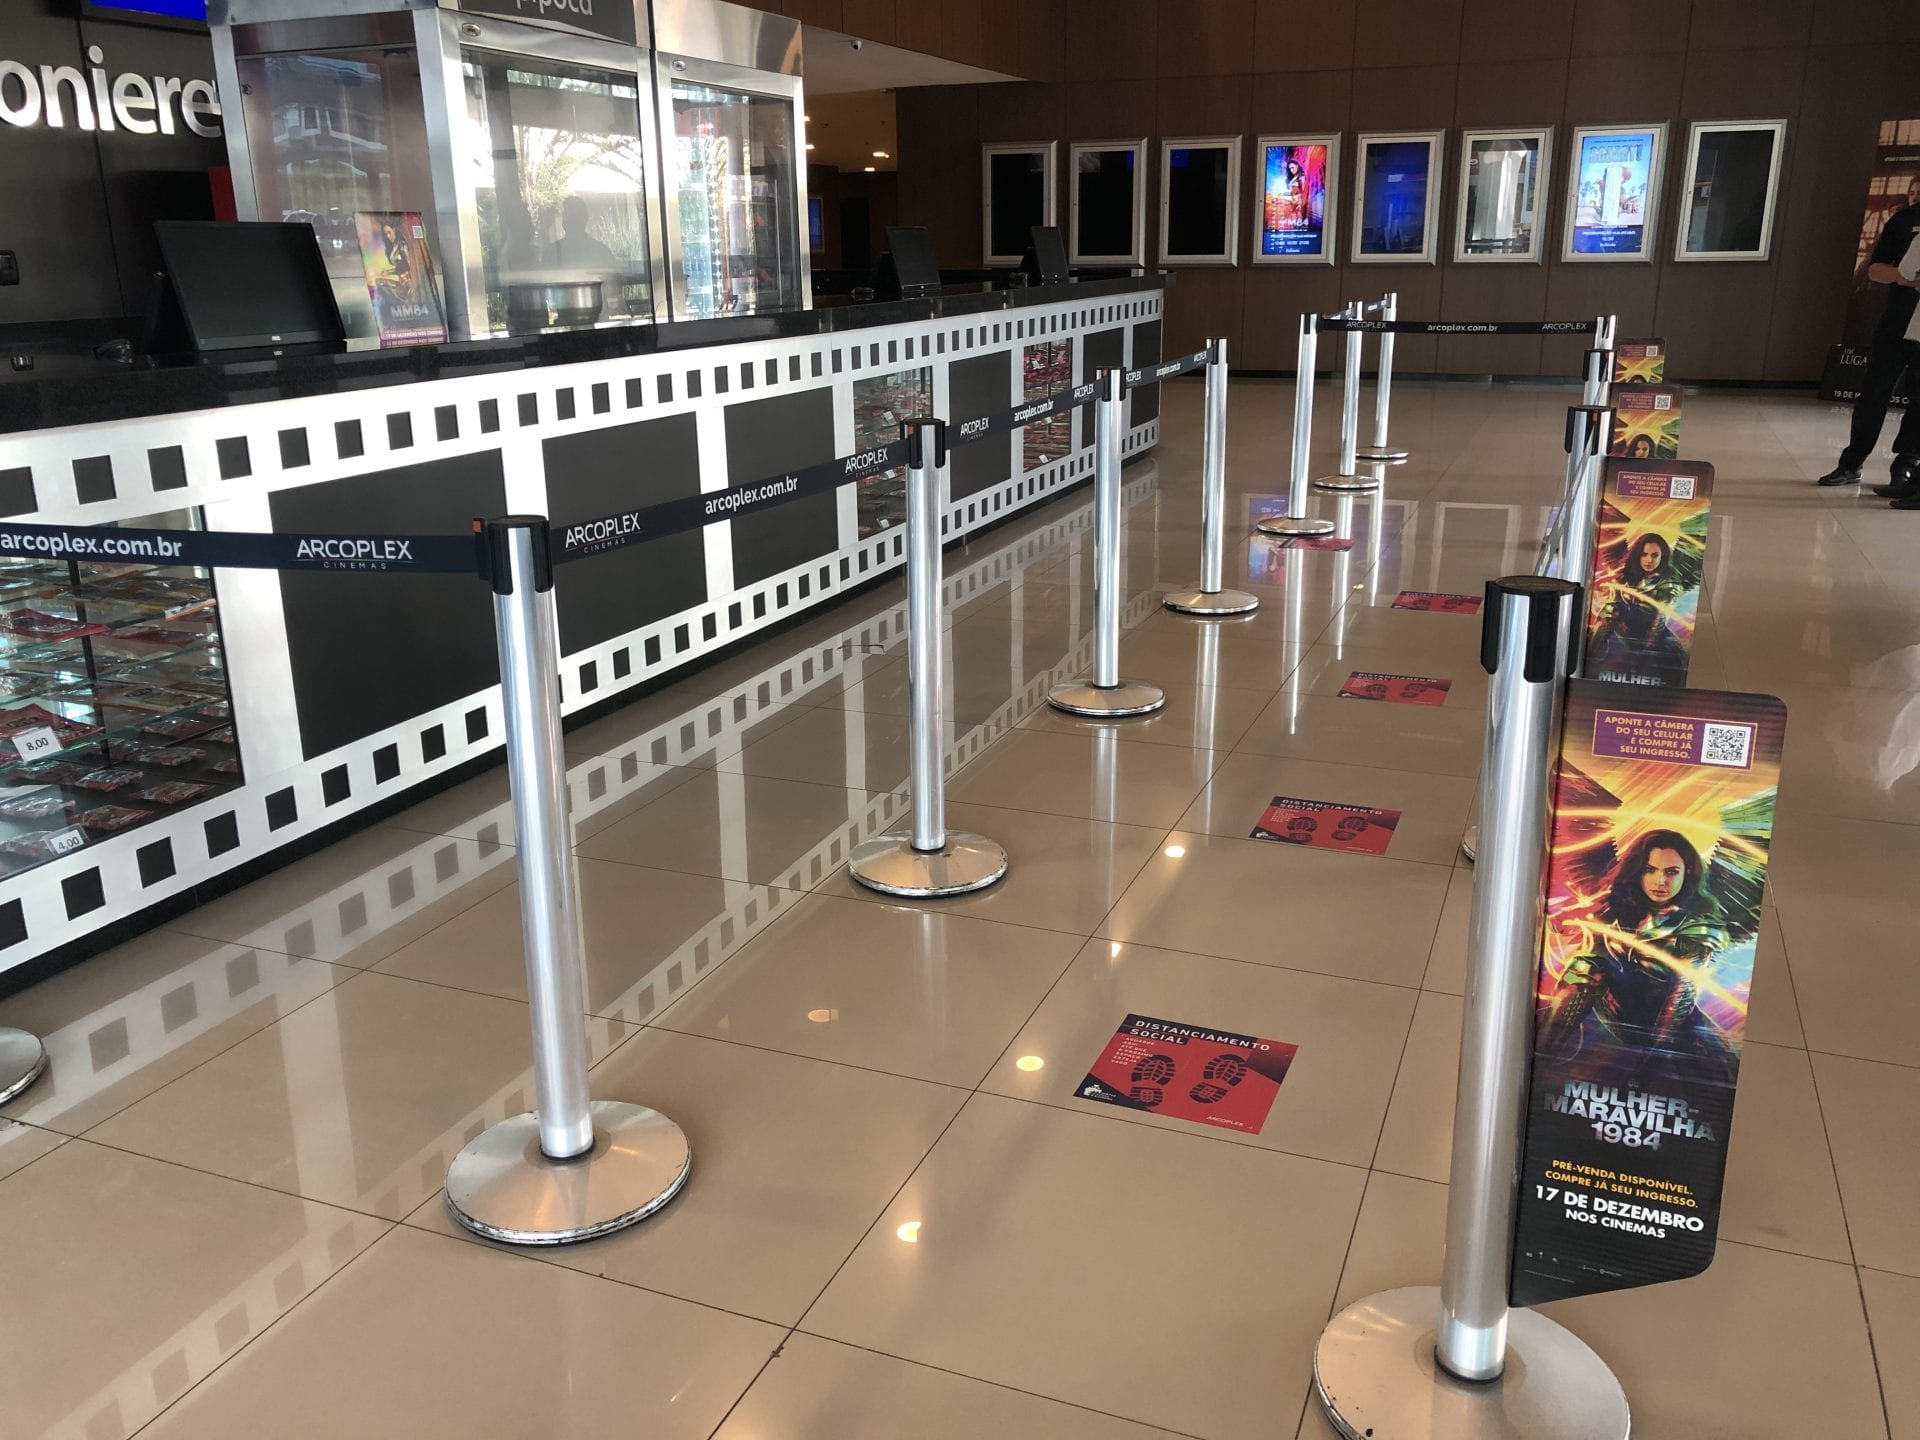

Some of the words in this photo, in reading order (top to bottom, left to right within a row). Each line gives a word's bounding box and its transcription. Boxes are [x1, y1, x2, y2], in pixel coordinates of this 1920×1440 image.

[1427, 323, 1498, 333] arcoplex.com.br
[1541, 322, 1588, 331] ARCOPLEX
[960, 417, 990, 437] ARCOPLEX
[1014, 399, 1054, 422] arcoplex.com.br
[1073, 383, 1094, 400] ARCOPLEX
[565, 512, 641, 549] ARCOPLEX
[705, 476, 798, 515] arcoplex.com.br
[845, 447, 888, 474] ARCOPLEX
[0, 531, 182, 557] arcoplex.com.br
[296, 538, 412, 560] ARCOPLEX
[584, 537, 626, 554] CINEMAS
[323, 561, 388, 570] CINEMAS
[1604, 716, 1643, 727] APONTE
[1645, 719, 1651, 727] A
[1654, 718, 1694, 731] CÂMERA
[1616, 726, 1630, 735] DO
[1633, 728, 1651, 736] SEU
[1653, 730, 1693, 740] CELULAR
[26, 737, 49, 751] 8,00
[1619, 745, 1637, 754] SEU
[1639, 747, 1691, 759] INGRESSO.
[1638, 738, 1678, 748] COMPRE
[1680, 739, 1692, 750] JÁ
[1279, 803, 1320, 812] SOCIAL
[1282, 799, 1383, 815] DISTANCIAMENTO
[58, 836, 80, 851] 4,00
[1129, 1028, 1184, 1044] SOCIAL
[1135, 1020, 1270, 1051] DISTANCIAMENTO
[1564, 1080, 1699, 1118] MULHER-
[1543, 1093, 1716, 1142] MARAVILHA
[1591, 1121, 1662, 1150] 1984
[1552, 1159, 1616, 1180] PRÉ-VENDA
[1619, 1173, 1693, 1195] DISPONÍVEL.
[1545, 1170, 1591, 1187] COMPRE
[1594, 1178, 1607, 1190] JÁ
[1611, 1183, 1633, 1196] SEU
[1636, 1188, 1699, 1209] INGRESSO.
[1535, 1185, 1560, 1201] 17
[1563, 1191, 1589, 1209] DE
[1593, 1197, 1704, 1232] DEZEMBRO
[1565, 1209, 1597, 1225] NOS
[1600, 1216, 1666, 1239] CINEMAS
